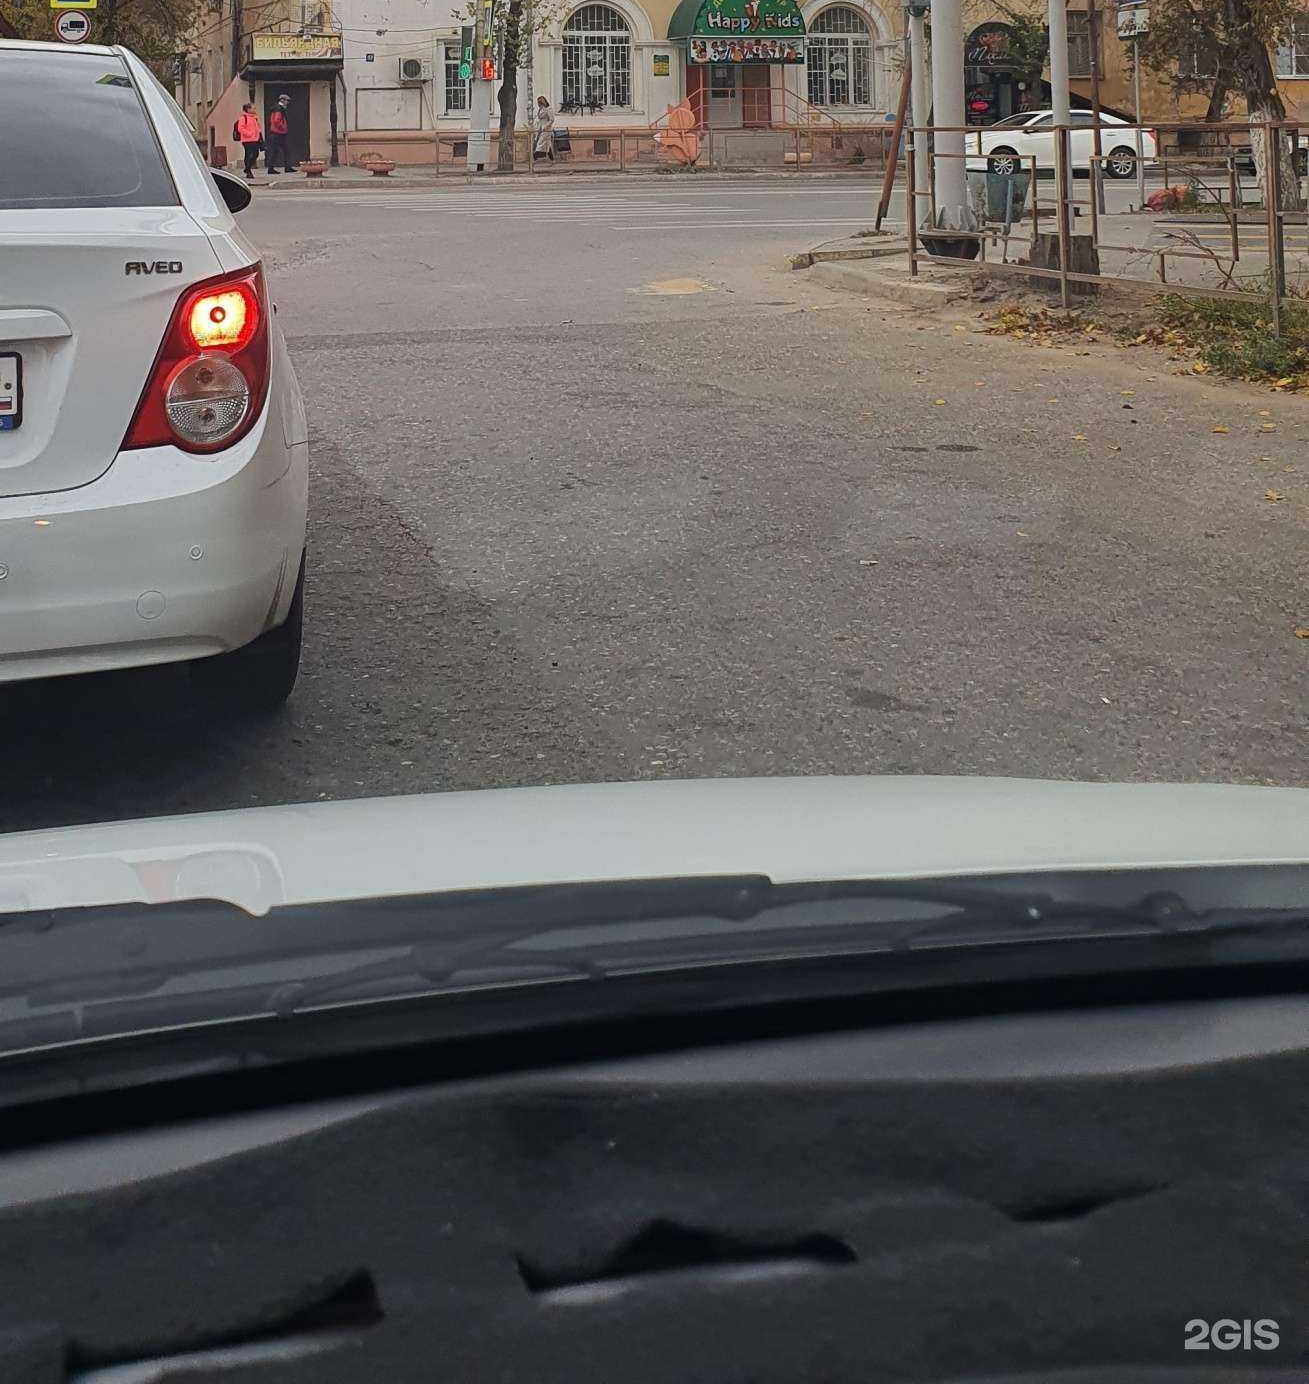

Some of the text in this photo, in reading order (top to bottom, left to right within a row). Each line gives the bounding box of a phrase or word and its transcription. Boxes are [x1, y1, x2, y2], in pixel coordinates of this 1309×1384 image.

[707, 11, 801, 34] Happy Kids
[125, 261, 183, 276] AVEO
